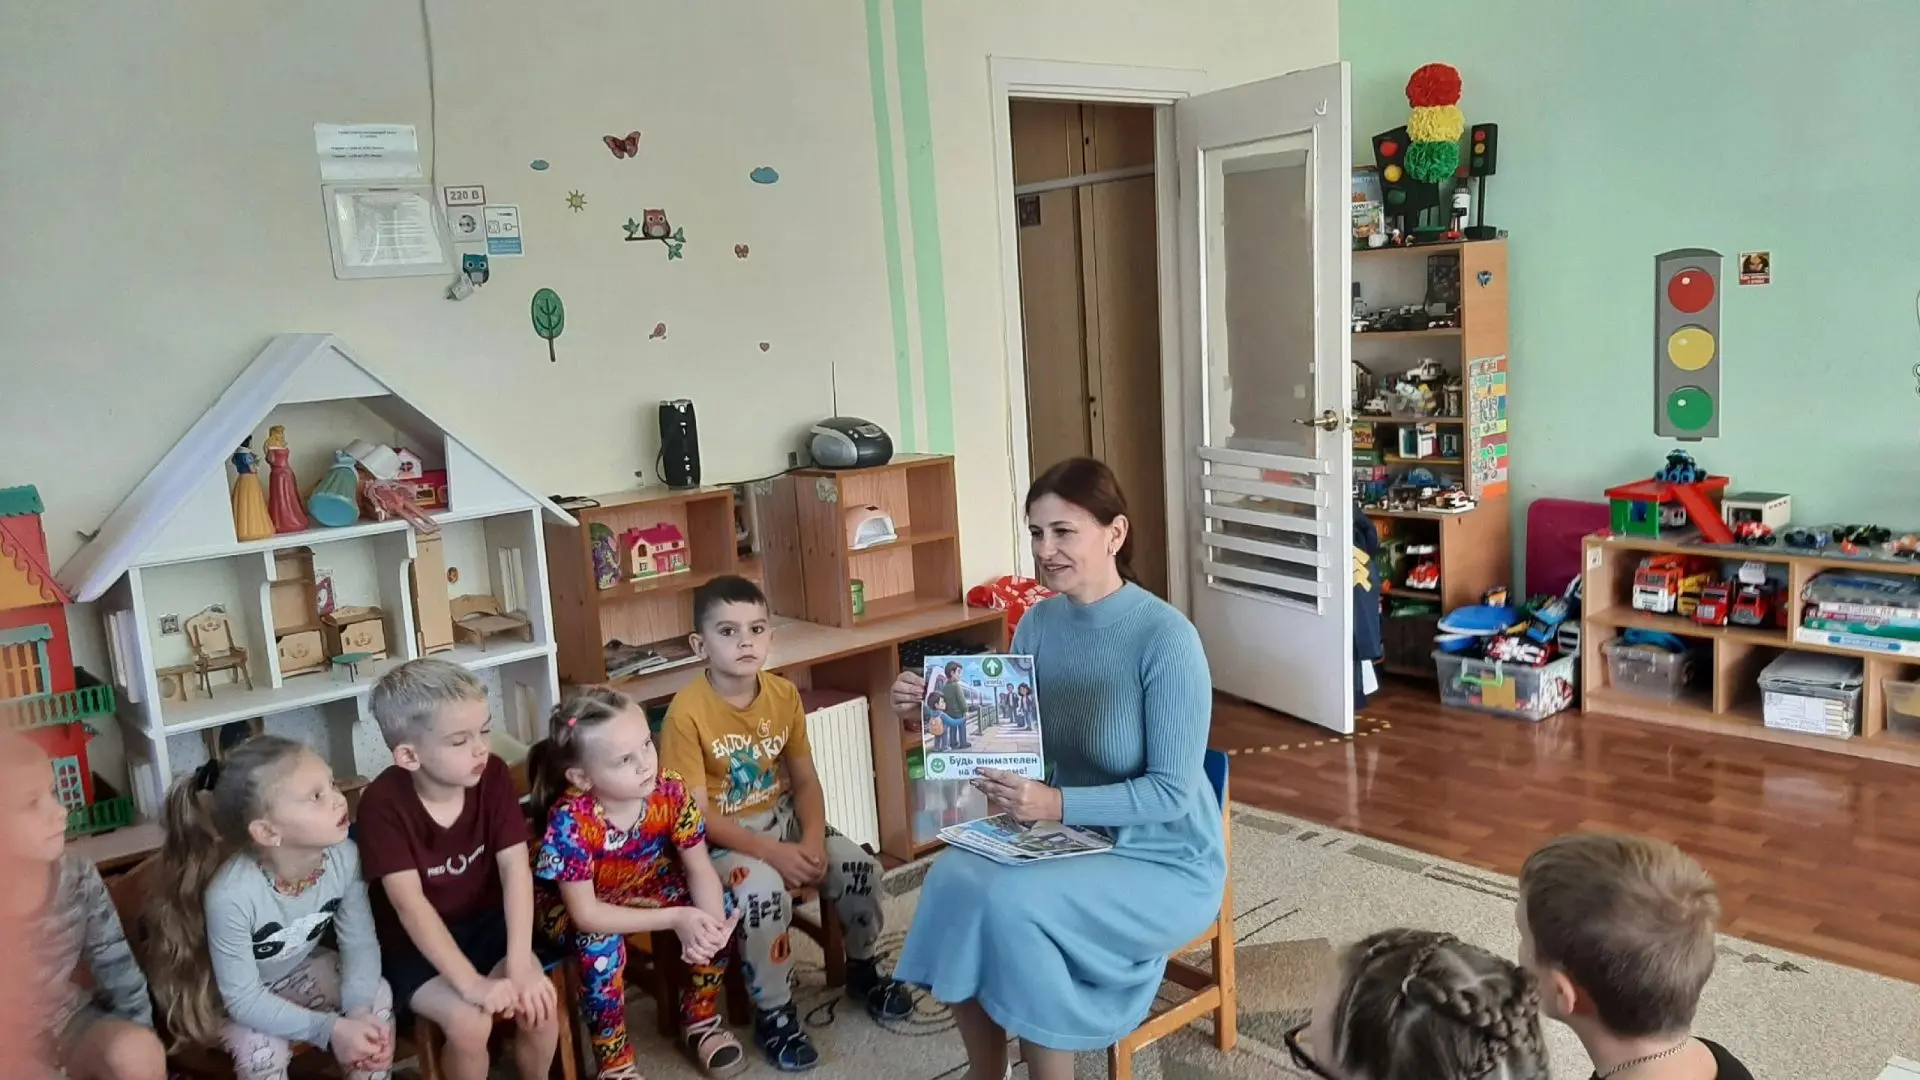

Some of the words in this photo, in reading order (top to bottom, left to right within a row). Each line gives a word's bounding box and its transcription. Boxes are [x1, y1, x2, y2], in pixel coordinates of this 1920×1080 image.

[450, 191, 468, 200] 220
[712, 734, 752, 759] ENJOY
[949, 755, 974, 767] Будь
[976, 756, 1038, 765] внимателен
